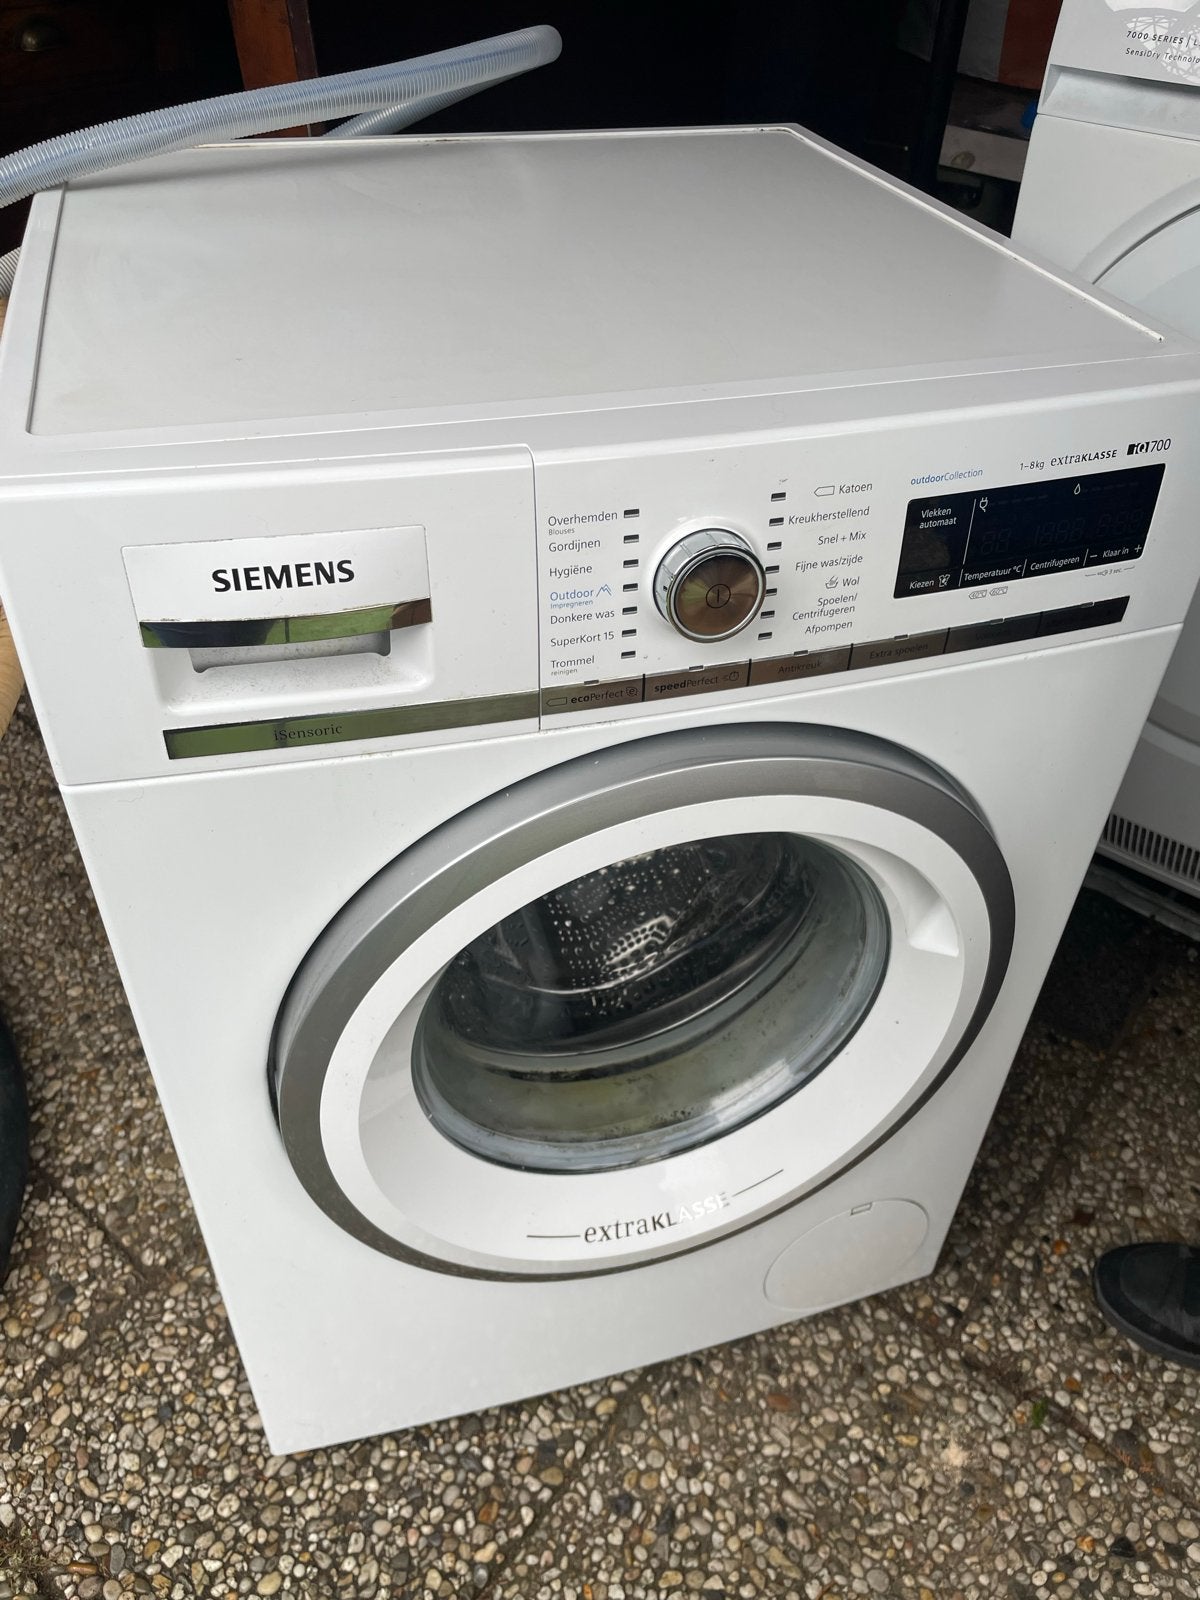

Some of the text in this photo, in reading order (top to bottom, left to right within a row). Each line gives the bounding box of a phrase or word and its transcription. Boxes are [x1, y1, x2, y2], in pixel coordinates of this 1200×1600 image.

[1126, 30, 1149, 41] 7000
[1151, 33, 1184, 45] SERIES
[1125, 47, 1161, 59] SensiDry
[1050, 449, 1118, 467] extraKLASSE
[910, 468, 984, 486] outdoorCollection
[838, 482, 873, 495] Katoen
[547, 511, 618, 527] Overhemden
[788, 506, 871, 525] Kreukherstellend
[921, 507, 952, 519] Vlekken
[919, 517, 957, 529] automaat
[548, 527, 575, 536] Blouses
[817, 534, 839, 546] Snel
[849, 531, 867, 542] Mix
[548, 539, 601, 553] Gordijnen
[1102, 549, 1121, 558] Klaar
[1121, 547, 1129, 555] in
[795, 555, 864, 573] Fijne was/zijde
[1030, 556, 1080, 571] Centrifugeren
[211, 559, 355, 593] SIEMENS
[549, 564, 593, 579] Hygiëne
[964, 568, 1011, 582] Temperatuur
[842, 576, 860, 588] Wol
[909, 579, 935, 590] Kiezen
[550, 589, 594, 601] Outdoor
[817, 593, 858, 607] Spoelen/
[550, 599, 594, 610] Impregneren
[550, 608, 615, 625] Donkere was
[792, 605, 855, 621] Centrifugeren
[804, 620, 853, 636] Afpompen
[550, 630, 615, 648] SuperKort 15
[550, 655, 595, 669] Trommel
[869, 649, 895, 660] Extra
[550, 667, 578, 676] reinigen
[778, 660, 823, 674] Antikreuk
[654, 675, 719, 693] speedPerfect
[570, 689, 624, 705] ecoPerfect
[273, 723, 343, 741] iSensoric
[584, 1190, 730, 1244] extraKLASSE
